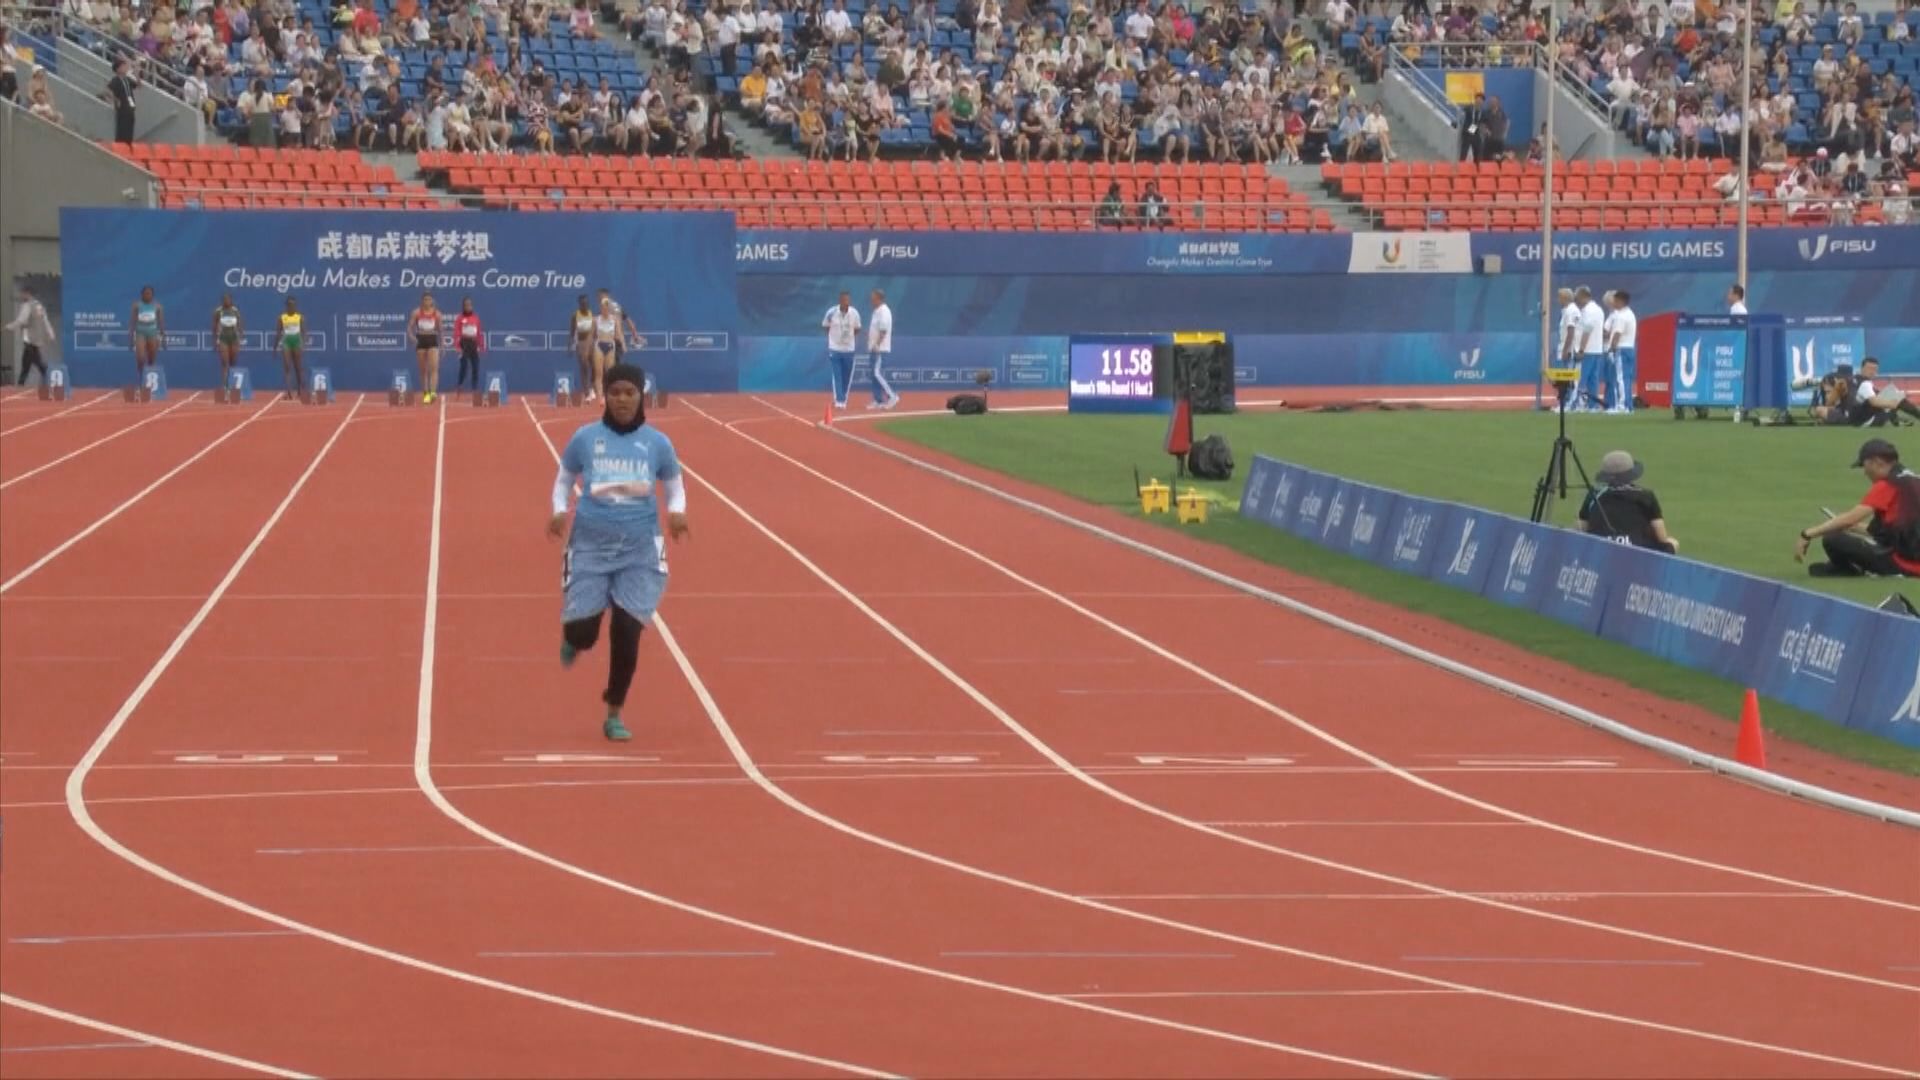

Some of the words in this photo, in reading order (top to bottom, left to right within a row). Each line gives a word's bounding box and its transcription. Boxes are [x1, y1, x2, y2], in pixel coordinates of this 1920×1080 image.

[318, 231, 493, 264] 成都成就梦想
[880, 245, 919, 259] FISU
[1516, 244, 1605, 260] CHNGDU
[1611, 243, 1651, 259] FISU
[1658, 242, 1724, 257] GAMES
[1830, 240, 1876, 253] FISU
[224, 267, 315, 293] Chengdu
[322, 267, 391, 288] Makes
[400, 268, 476, 288] Dreams
[482, 268, 540, 288] Come
[544, 270, 586, 288] True
[1831, 344, 1851, 353] FISU
[1102, 349, 1153, 375] 11.58
[50, 370, 63, 387] 9
[146, 372, 159, 391] 8
[232, 374, 244, 389] 7
[313, 374, 326, 390] 6
[395, 376, 407, 393] 5
[489, 377, 500, 393] 4
[557, 377, 570, 394] 3
[592, 459, 649, 475] SOMALIA
